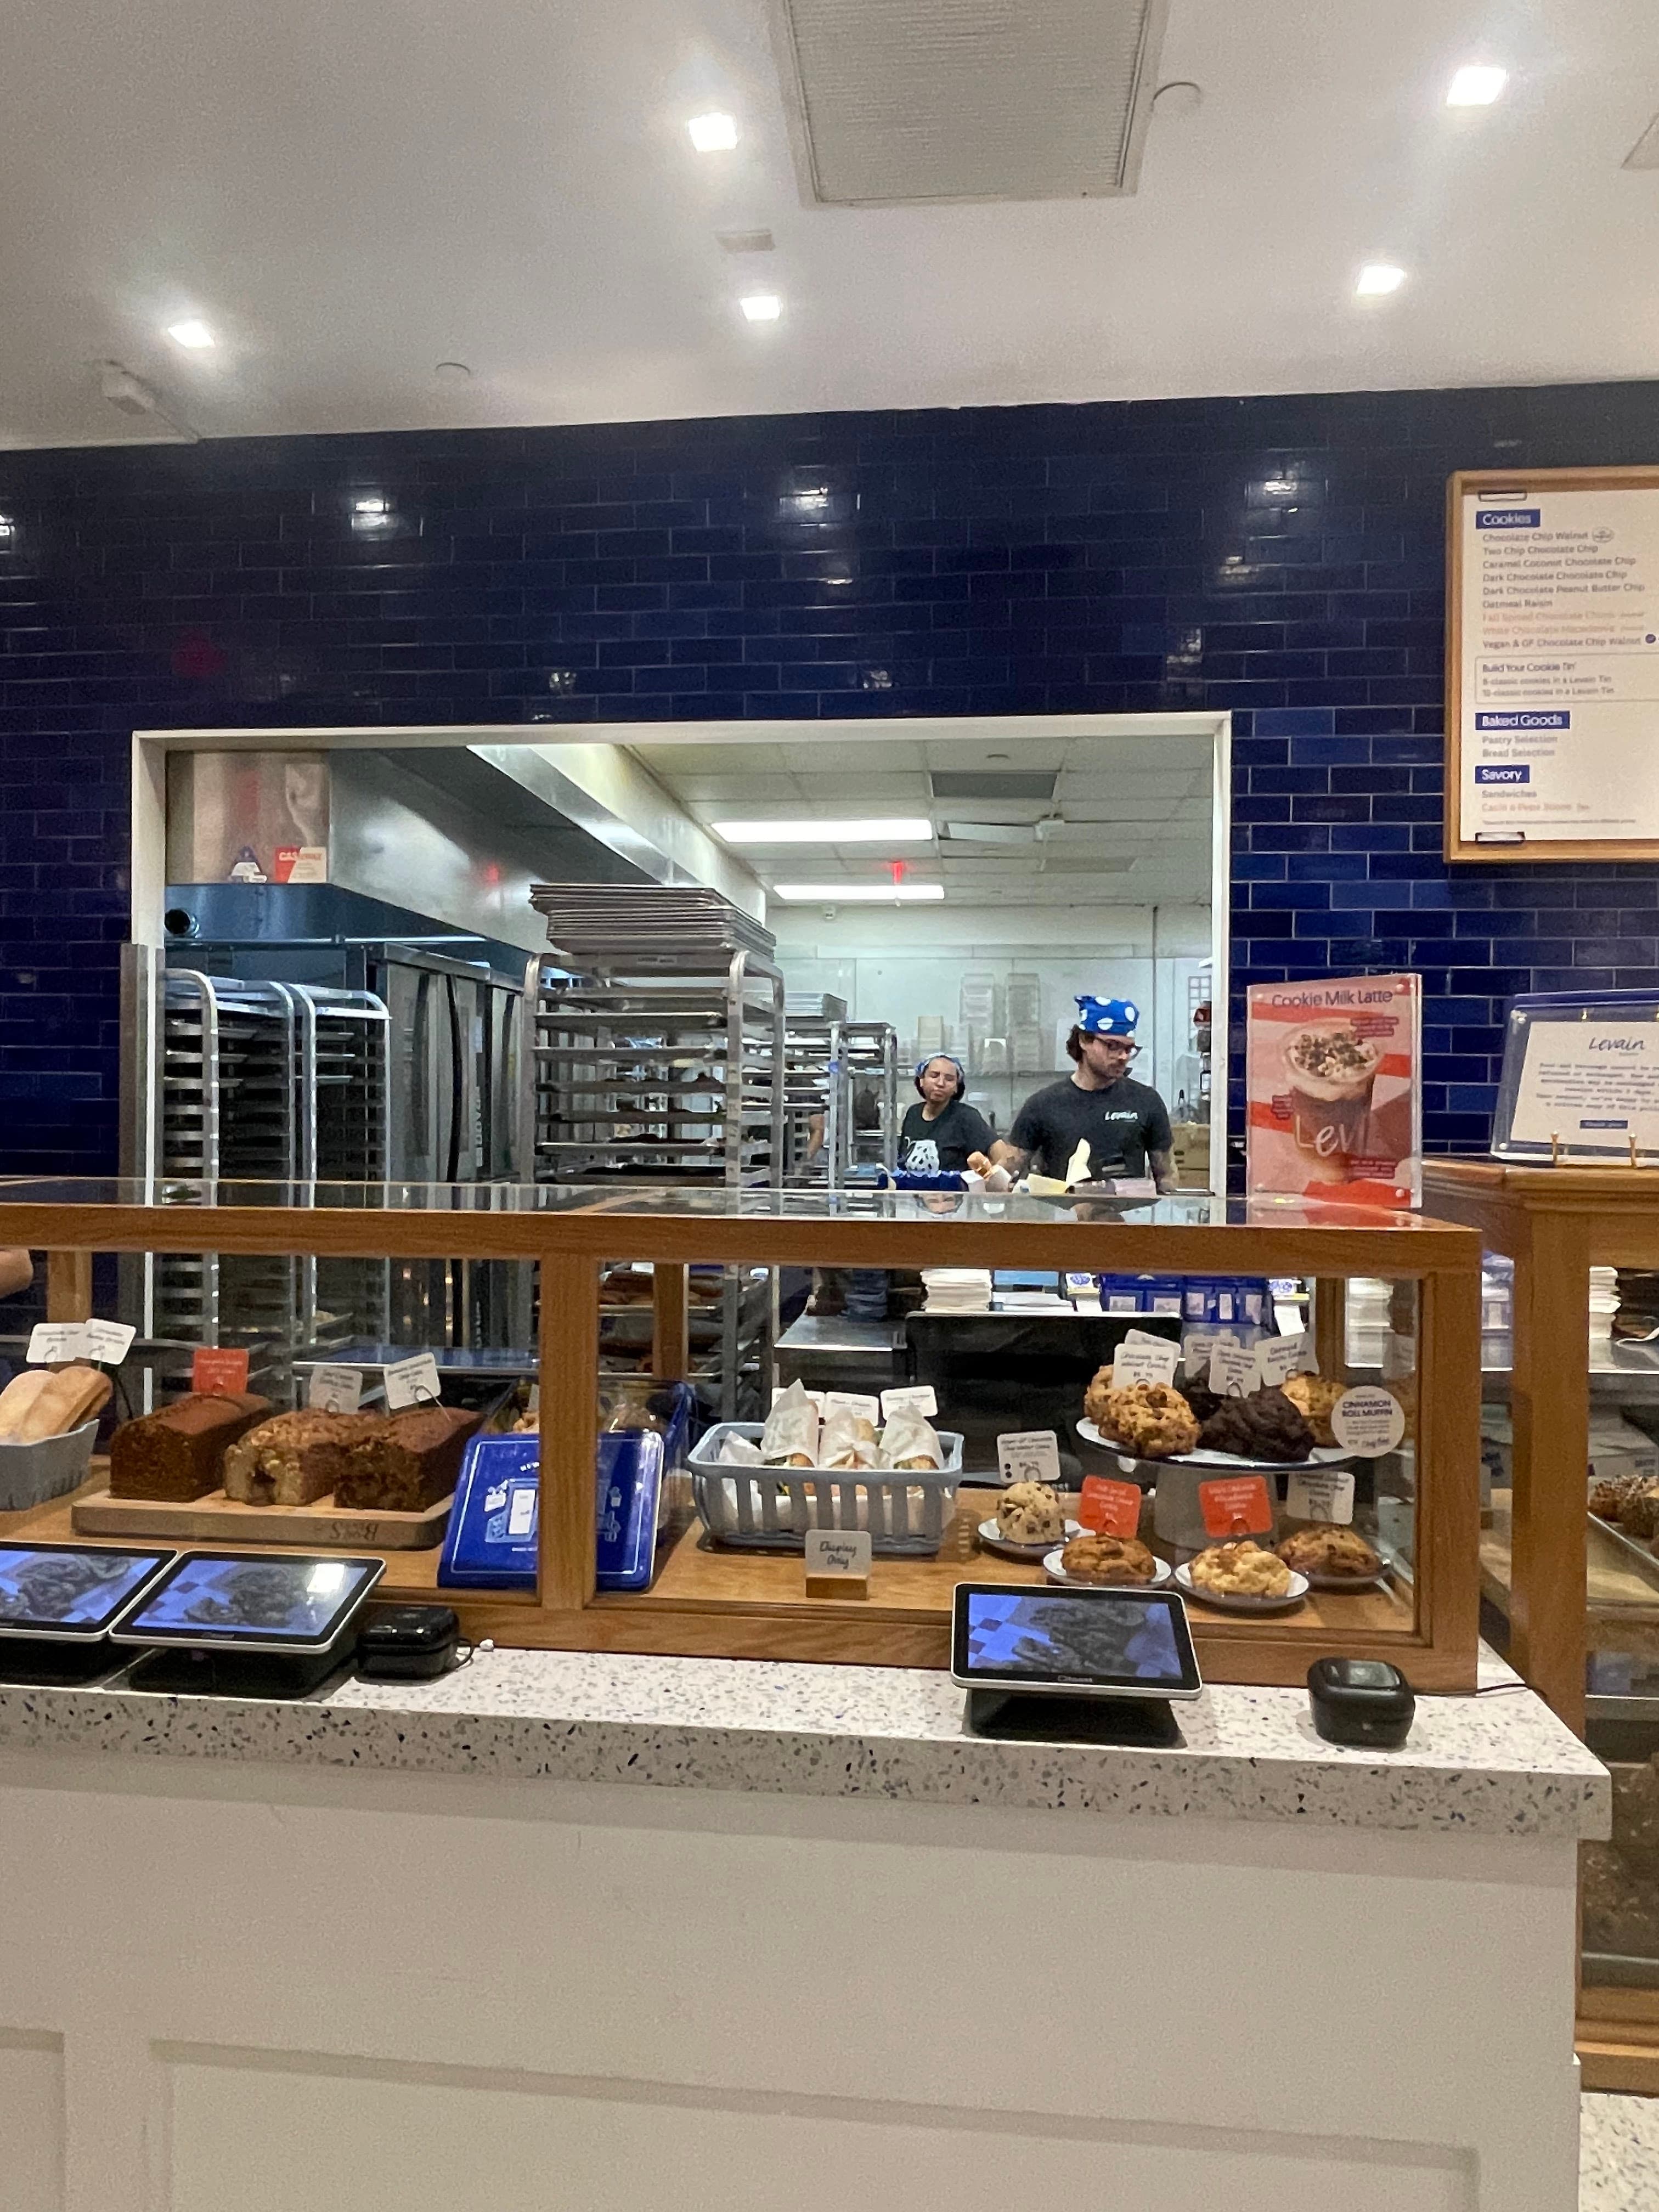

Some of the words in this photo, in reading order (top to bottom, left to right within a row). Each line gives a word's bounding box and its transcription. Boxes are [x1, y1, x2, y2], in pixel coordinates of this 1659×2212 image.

[1483, 512, 1531, 526] Cookies
[1532, 532, 1553, 541] Chip
[1555, 531, 1588, 539] Walnut
[1504, 546, 1525, 556] Chip
[1528, 545, 1575, 554] Chocolate
[1577, 545, 1598, 554] Chip
[1483, 560, 1521, 568] Caramel
[1523, 559, 1562, 567] Coconut
[1565, 557, 1612, 566] Chocolate
[1615, 556, 1636, 566] Chip
[1556, 571, 1604, 579] Chocolate
[1606, 571, 1627, 579] Chip
[1507, 585, 1554, 594] Chocolate
[1556, 585, 1588, 593] Peanut
[1592, 584, 1620, 592] Butter
[1624, 583, 1645, 591] Chip
[1483, 600, 1521, 608] Oatmeal
[1483, 640, 1510, 650] Vegan
[1537, 638, 1583, 647] Chocolate
[1586, 637, 1606, 646] Chip
[1609, 636, 1641, 645] Walnut
[1483, 663, 1504, 672] Build
[1506, 664, 1525, 672] Your
[1527, 663, 1560, 672] Cookie
[1482, 714, 1519, 726] Baked
[1521, 714, 1562, 726] Goods
[1482, 736, 1512, 745] Pastry
[1514, 735, 1558, 743] Selection
[1482, 749, 1509, 757] Bread
[1512, 748, 1555, 757] Selection
[1482, 769, 1523, 782] Savory
[1482, 789, 1537, 799] Sandwiches
[1272, 992, 1322, 1008] Cookie
[1325, 990, 1355, 1006] Milk
[1358, 990, 1393, 1004] Latte
[1589, 1036, 1645, 1051] Levain
[1342, 1400, 1391, 1408] CINNAMON
[820, 1541, 857, 1558] Display
[827, 1554, 849, 1570] Only
